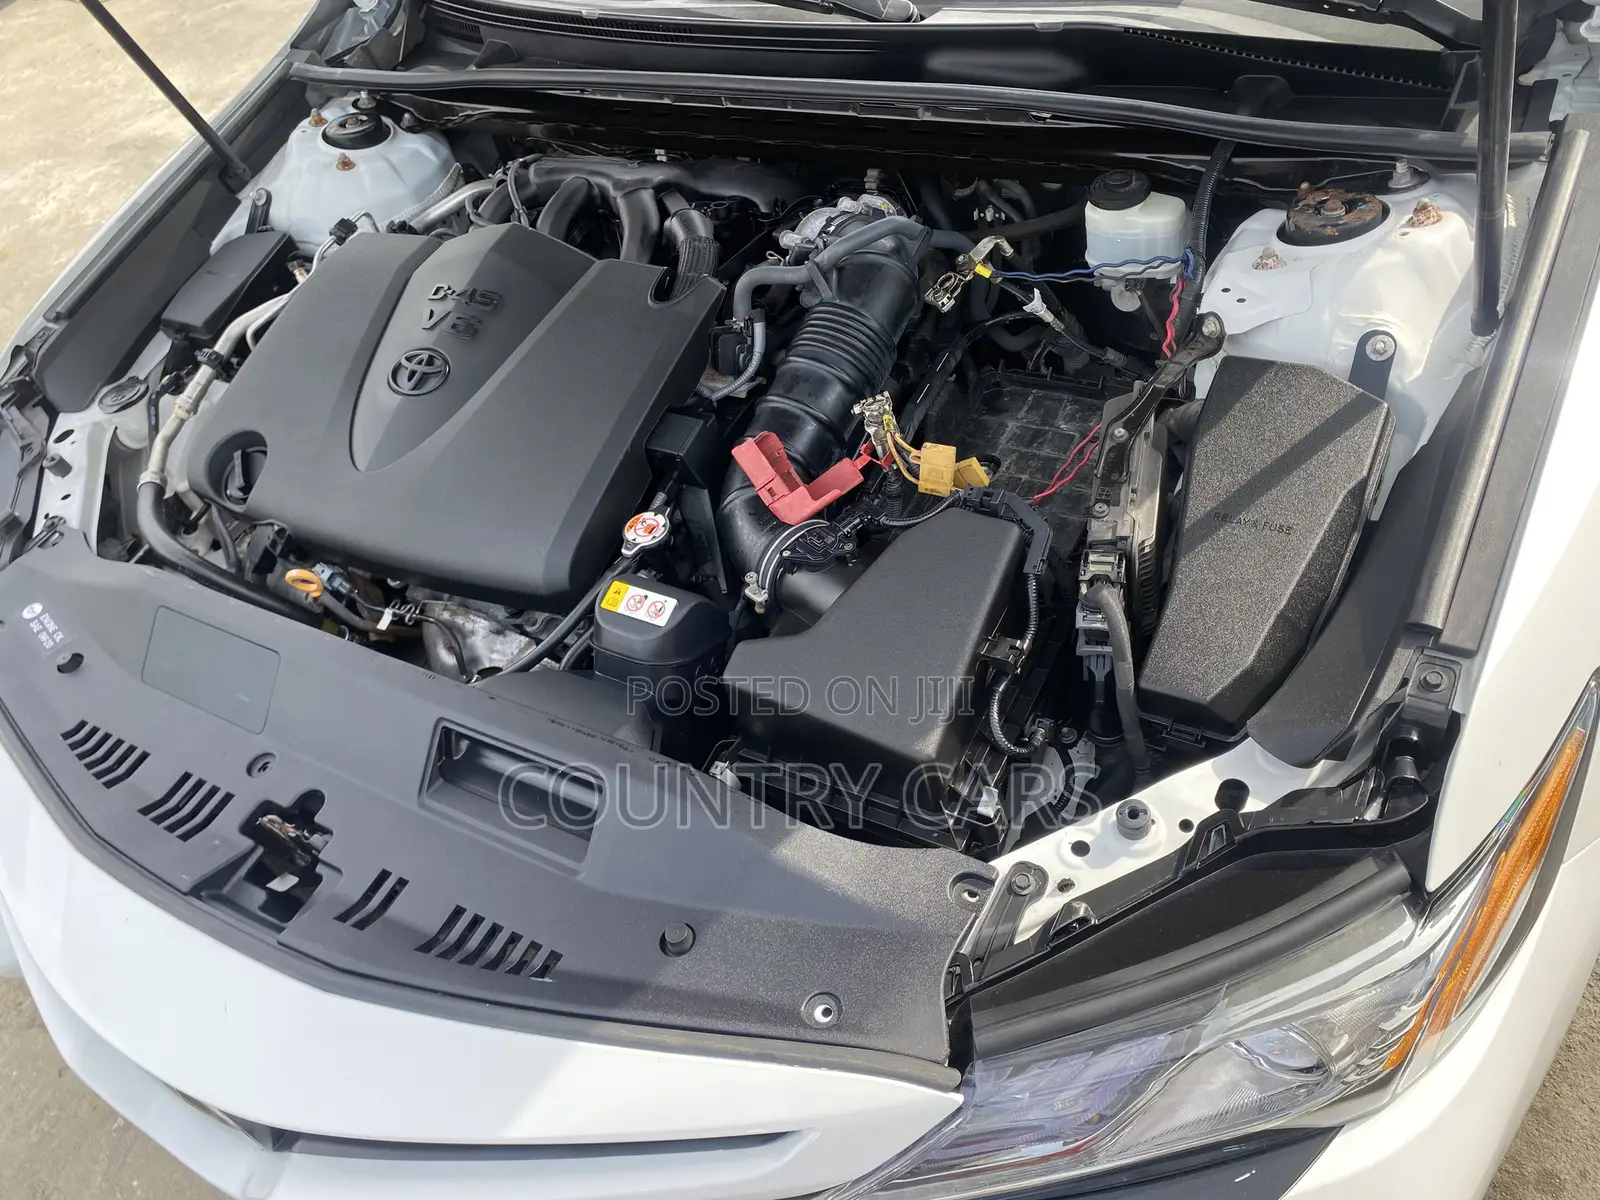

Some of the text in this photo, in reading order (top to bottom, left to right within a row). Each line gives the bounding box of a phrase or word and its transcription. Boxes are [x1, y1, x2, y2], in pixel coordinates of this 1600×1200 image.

[421, 308, 482, 339] V6
[1213, 511, 1250, 525] RELAY
[1262, 521, 1293, 535] FUSE
